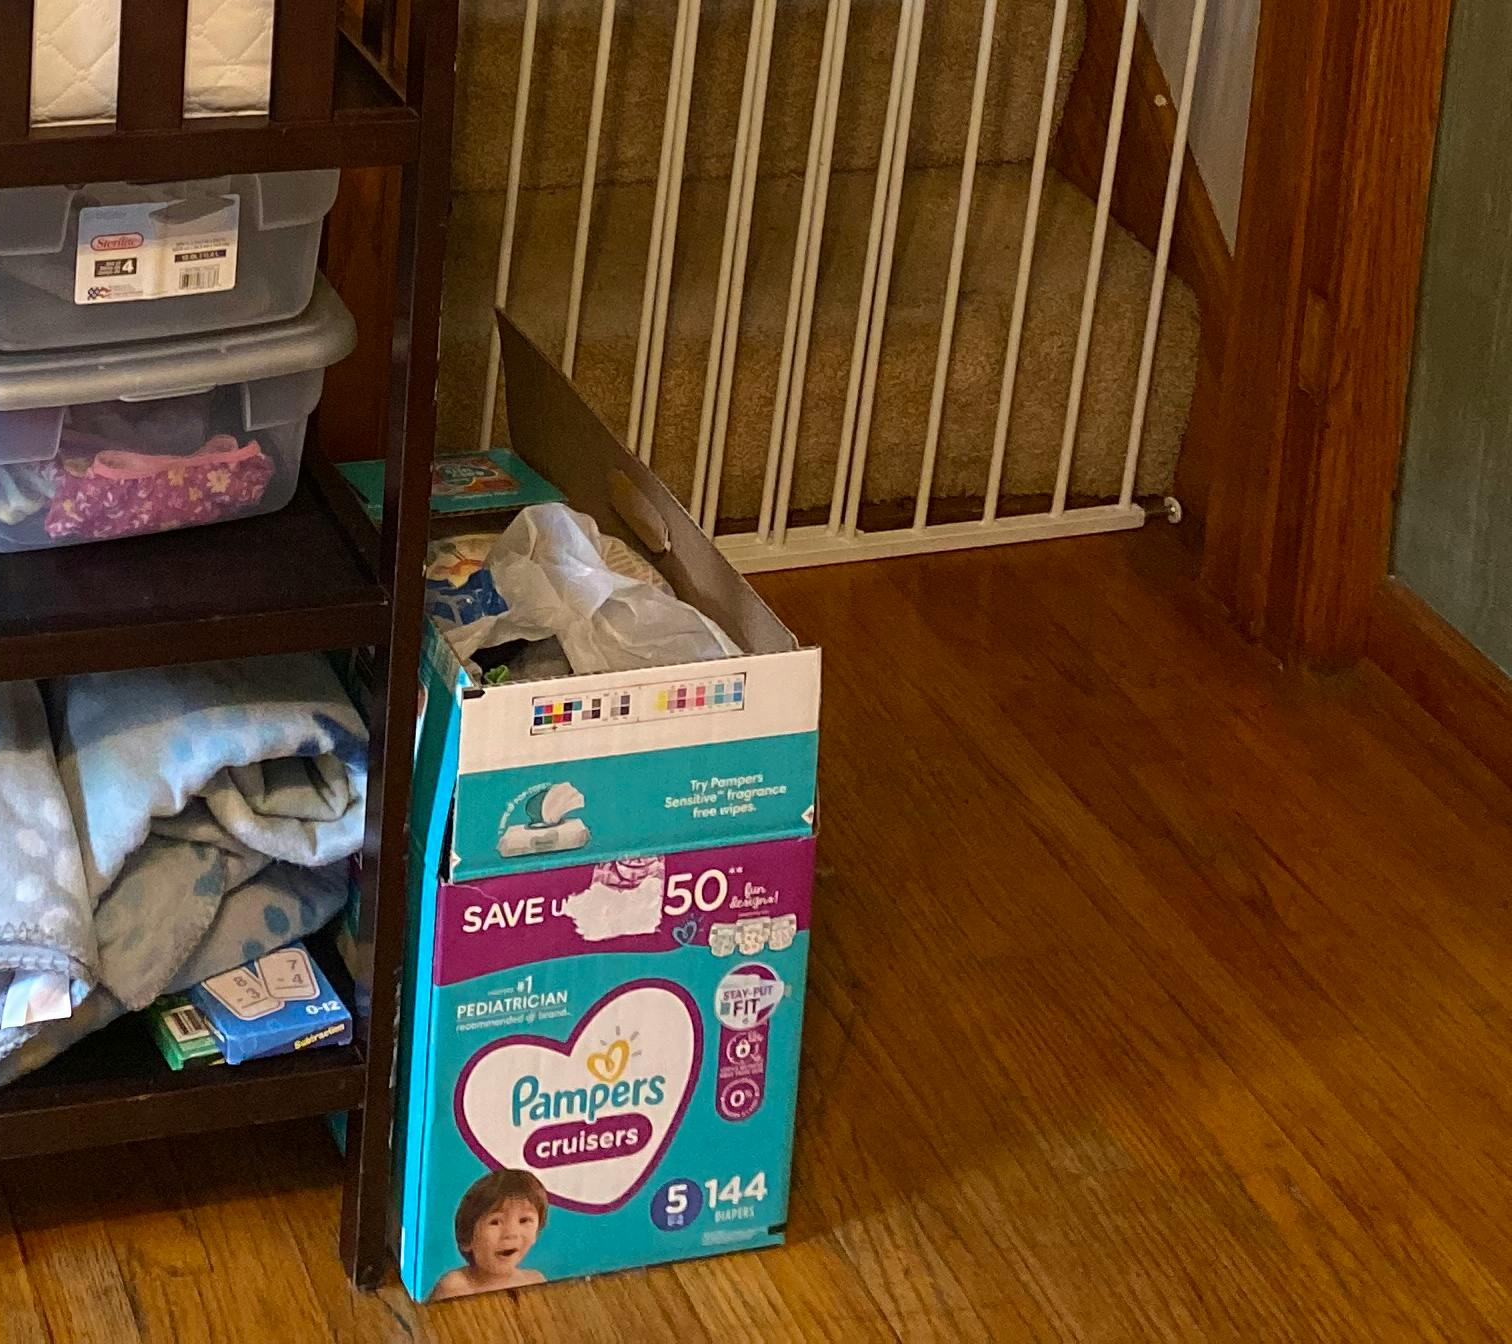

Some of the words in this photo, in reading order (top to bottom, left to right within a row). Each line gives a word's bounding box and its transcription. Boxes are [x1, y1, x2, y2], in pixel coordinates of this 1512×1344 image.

[96, 235, 138, 250] Sterilite
[122, 259, 134, 273] 4
[690, 779, 708, 794] Try
[711, 774, 763, 788] Pampers
[727, 785, 787, 801] fragrance
[693, 807, 717, 818] free
[720, 803, 756, 817] wipes.
[744, 882, 767, 898] fun
[729, 891, 779, 910] designs!
[462, 897, 545, 933] SAVE
[286, 959, 297, 971] 7
[723, 985, 774, 1001] STAY-PUT
[306, 1000, 341, 1015] 0-12
[456, 990, 568, 1018] PEDIATRICIAN
[733, 999, 760, 1016] FIT
[294, 1023, 345, 1050] Subtraction
[512, 1074, 666, 1127] Pampers
[535, 1126, 639, 1159] cruisers
[665, 1184, 688, 1214] 5
[704, 1171, 768, 1209] 144
[714, 1206, 755, 1223] DIAPERS
